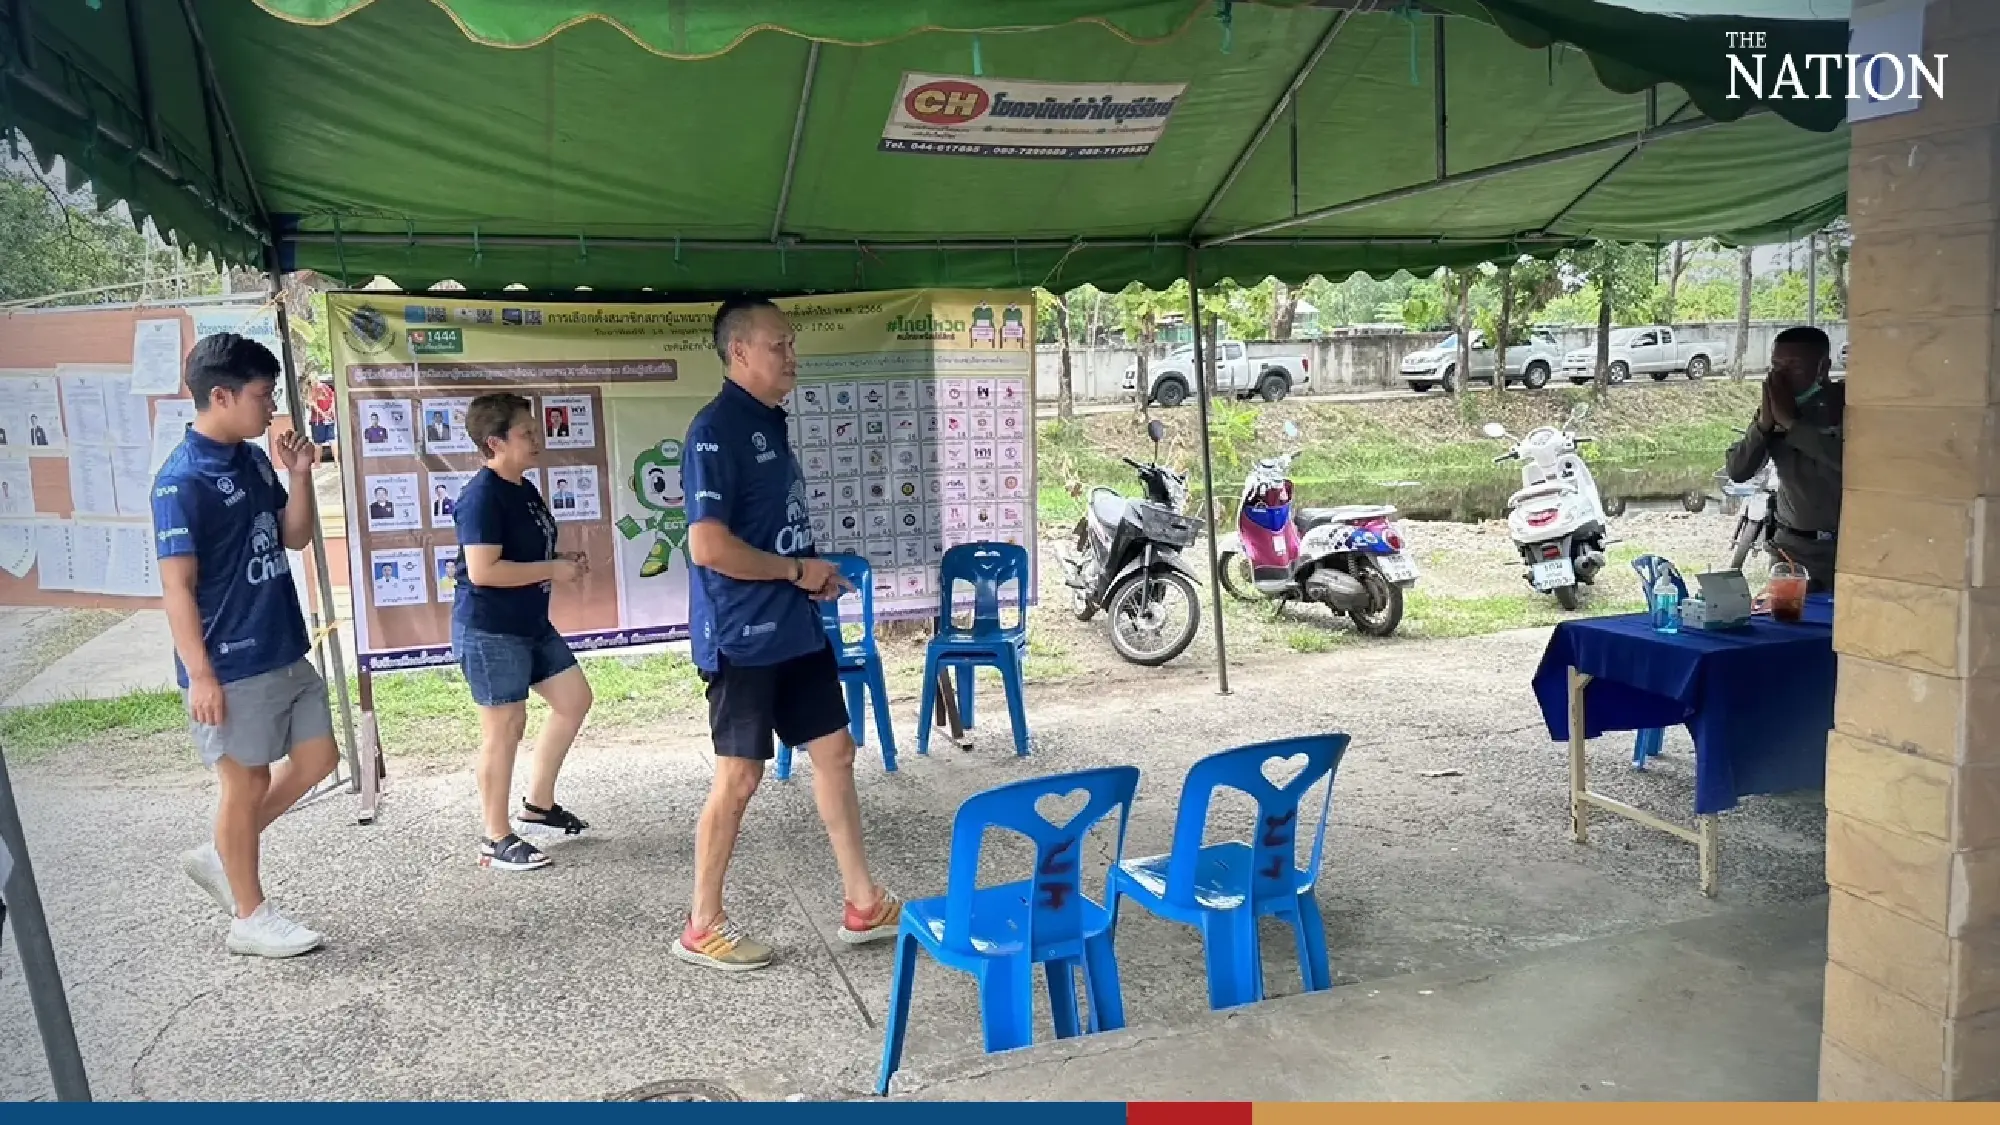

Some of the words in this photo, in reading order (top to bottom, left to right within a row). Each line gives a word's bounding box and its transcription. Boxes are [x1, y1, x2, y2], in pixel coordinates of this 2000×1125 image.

[913, 90, 979, 117] CH
[857, 303, 883, 314] 2566
[427, 331, 456, 342] 1444
